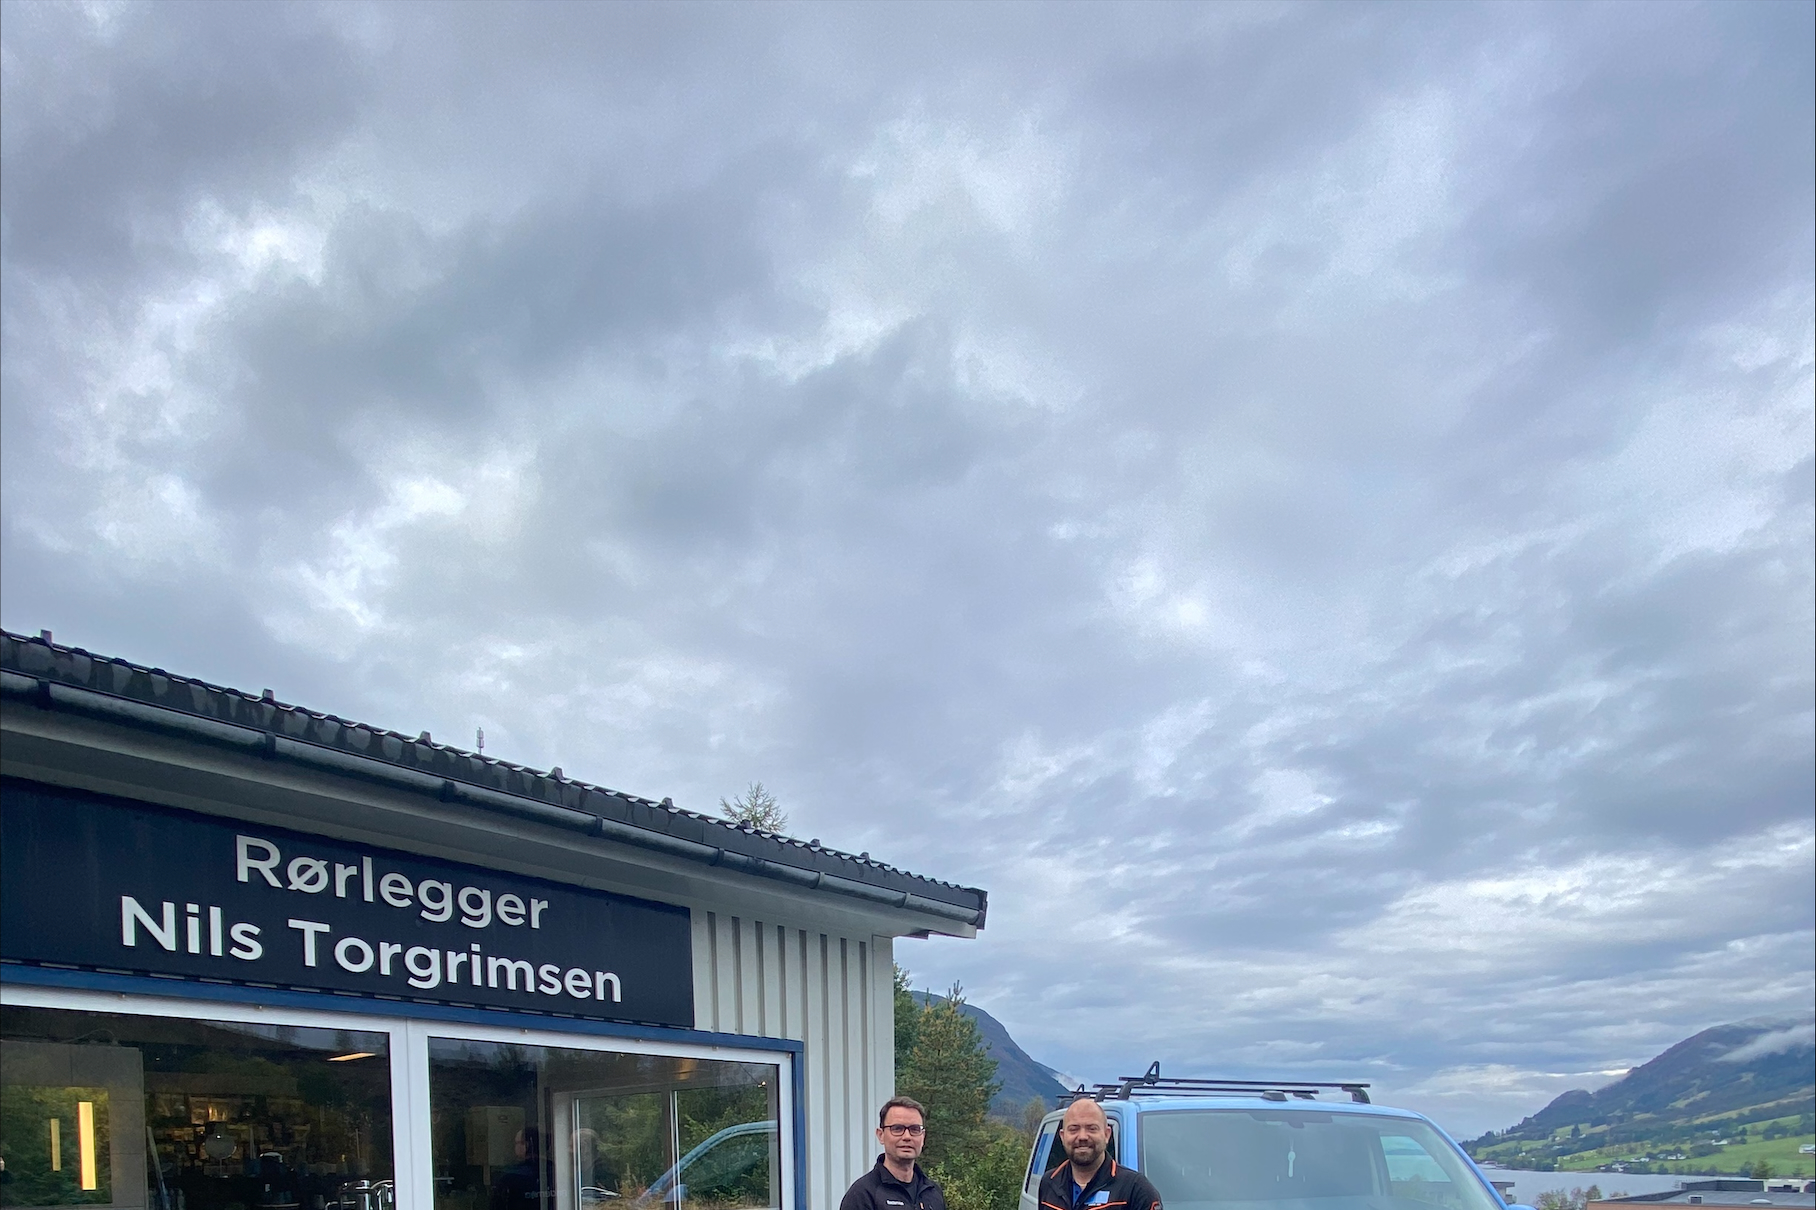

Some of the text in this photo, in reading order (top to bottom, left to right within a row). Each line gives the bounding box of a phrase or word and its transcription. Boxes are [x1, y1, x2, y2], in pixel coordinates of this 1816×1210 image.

[236, 834, 549, 929] Rørlegger
[121, 895, 622, 1003] Nils Torgrimsen
